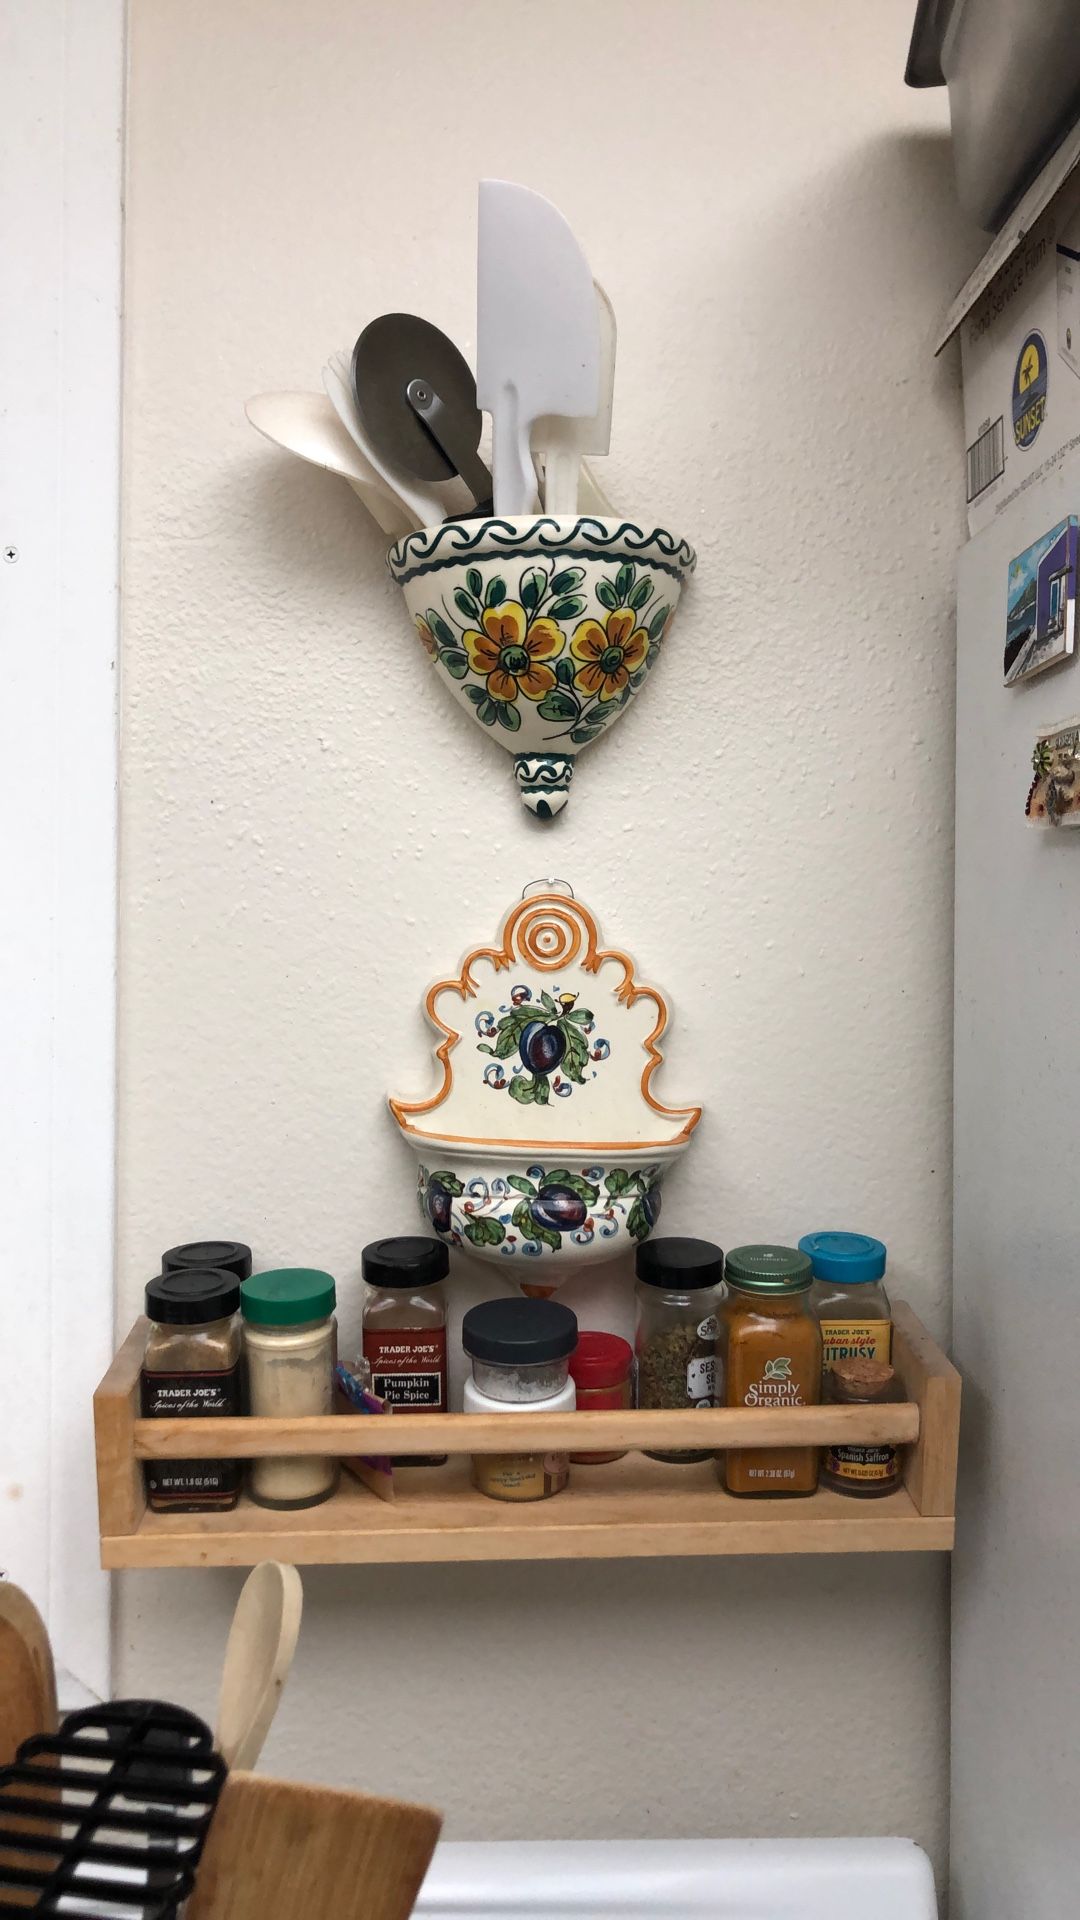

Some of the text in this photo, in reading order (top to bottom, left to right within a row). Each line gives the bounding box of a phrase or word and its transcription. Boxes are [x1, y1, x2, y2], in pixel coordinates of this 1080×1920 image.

[992, 265, 1023, 320] Service
[1024, 237, 1047, 277] Film
[1014, 395, 1047, 447] SUNSET
[823, 1335, 876, 1346] uban style
[379, 1345, 435, 1354] TRADER JOE'S
[823, 1347, 877, 1362] ITRUSY
[372, 1355, 440, 1367] Spices of the World
[384, 1377, 429, 1389] Pumpkin
[157, 1388, 218, 1398] TRADER JOE'S
[384, 1390, 429, 1401] Pie Spice
[749, 1381, 800, 1399] Simply
[151, 1398, 224, 1413] Spices of the World
[837, 1448, 889, 1463] Spanish Saffron
[162, 1478, 173, 1487] NET
